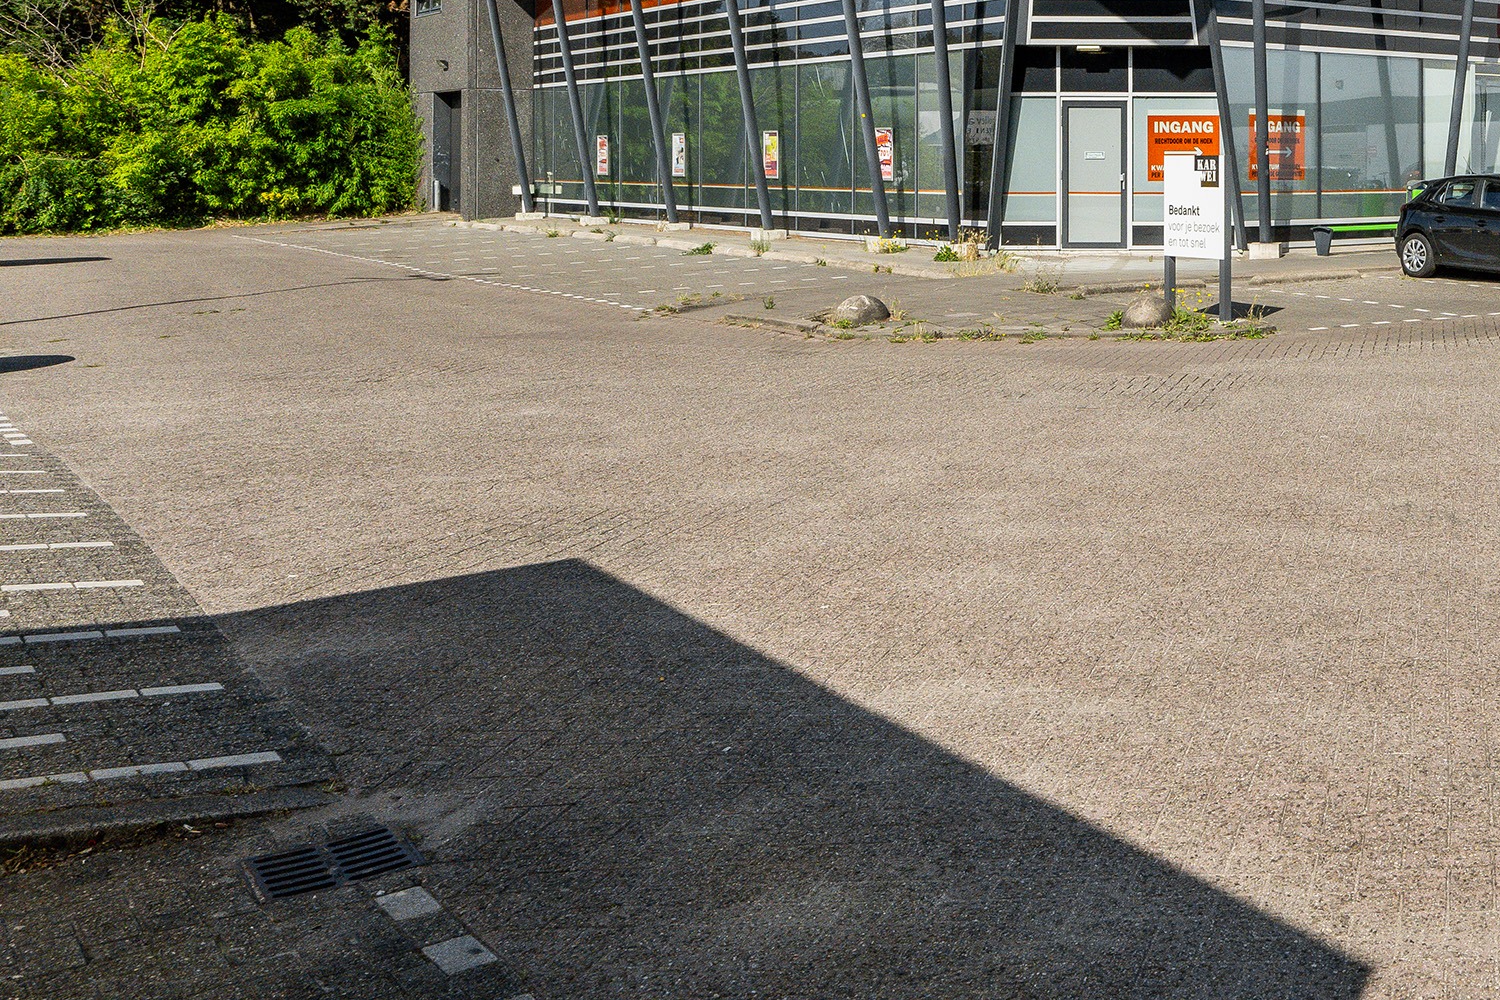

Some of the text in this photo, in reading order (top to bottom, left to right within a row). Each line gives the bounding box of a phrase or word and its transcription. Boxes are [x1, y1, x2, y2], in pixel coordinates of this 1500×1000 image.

[1153, 121, 1214, 134] INGANG
[1253, 120, 1301, 133] IGANG
[1154, 137, 1213, 145] RECHTDOOR OM DE HOEK
[1197, 159, 1217, 171] KAR
[1200, 171, 1217, 182] WEI
[1168, 204, 1200, 216] Bedankt
[1168, 221, 1220, 234] voor je bezoek
[1168, 237, 1206, 249] en tot snel
